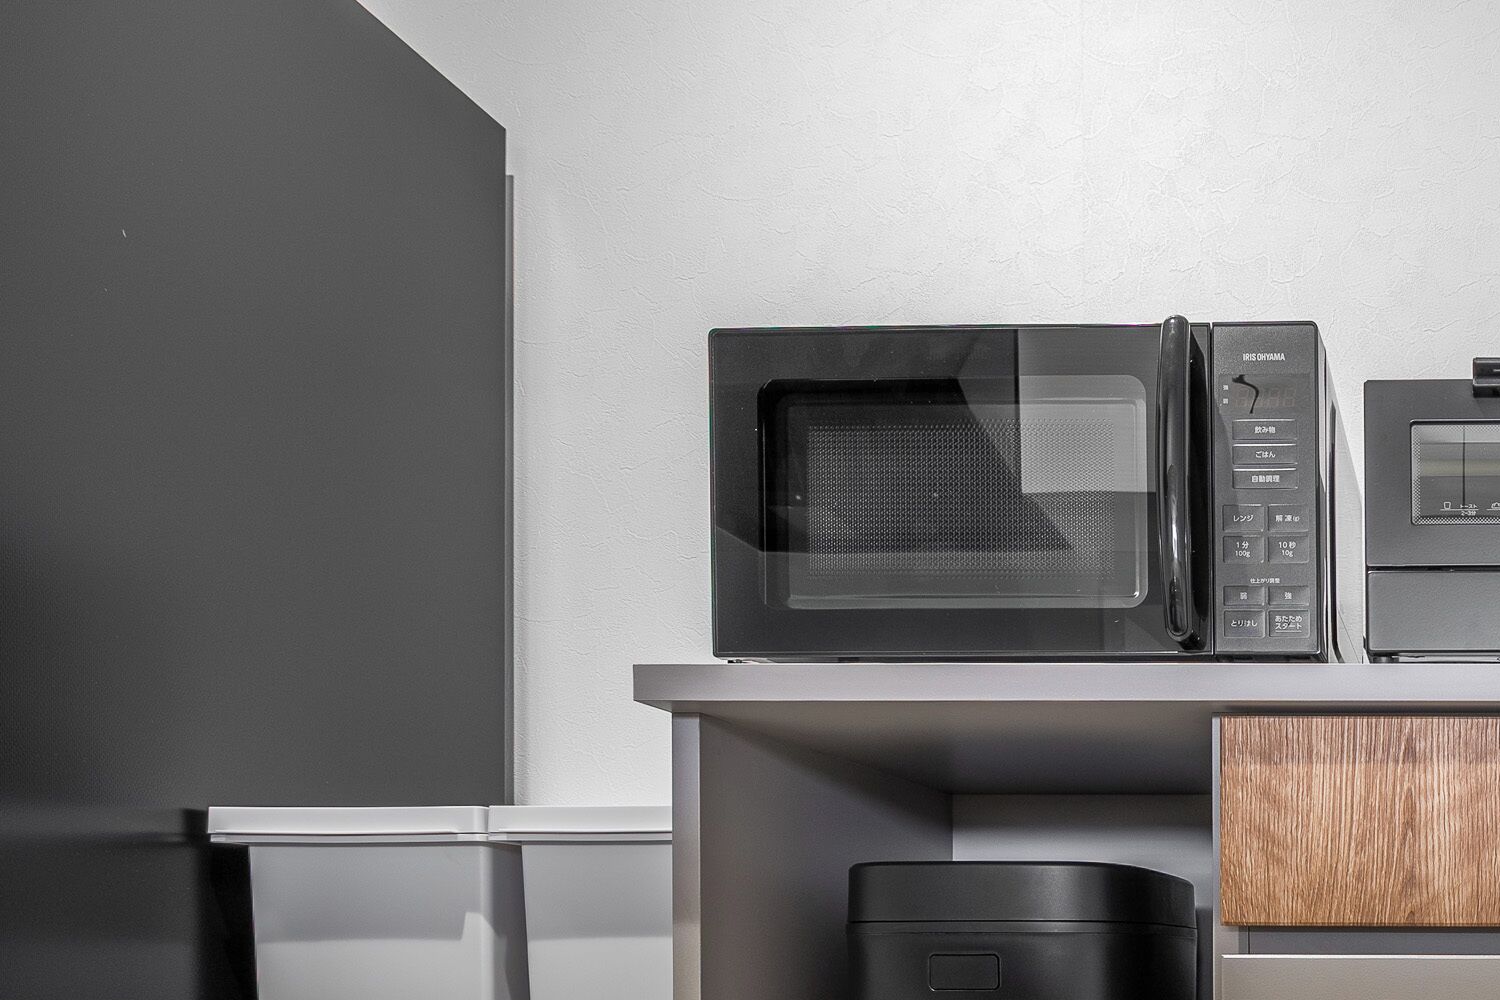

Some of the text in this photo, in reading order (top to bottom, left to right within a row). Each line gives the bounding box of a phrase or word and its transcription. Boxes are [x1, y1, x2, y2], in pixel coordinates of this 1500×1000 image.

[1243, 353, 1285, 361] IRIS OHYAMA
[1254, 426, 1276, 434] 飲み物
[1255, 450, 1276, 458] ごはん
[1235, 550, 1250, 558] 100g
[1284, 592, 1292, 600] 強
[1275, 622, 1302, 630] スタート
